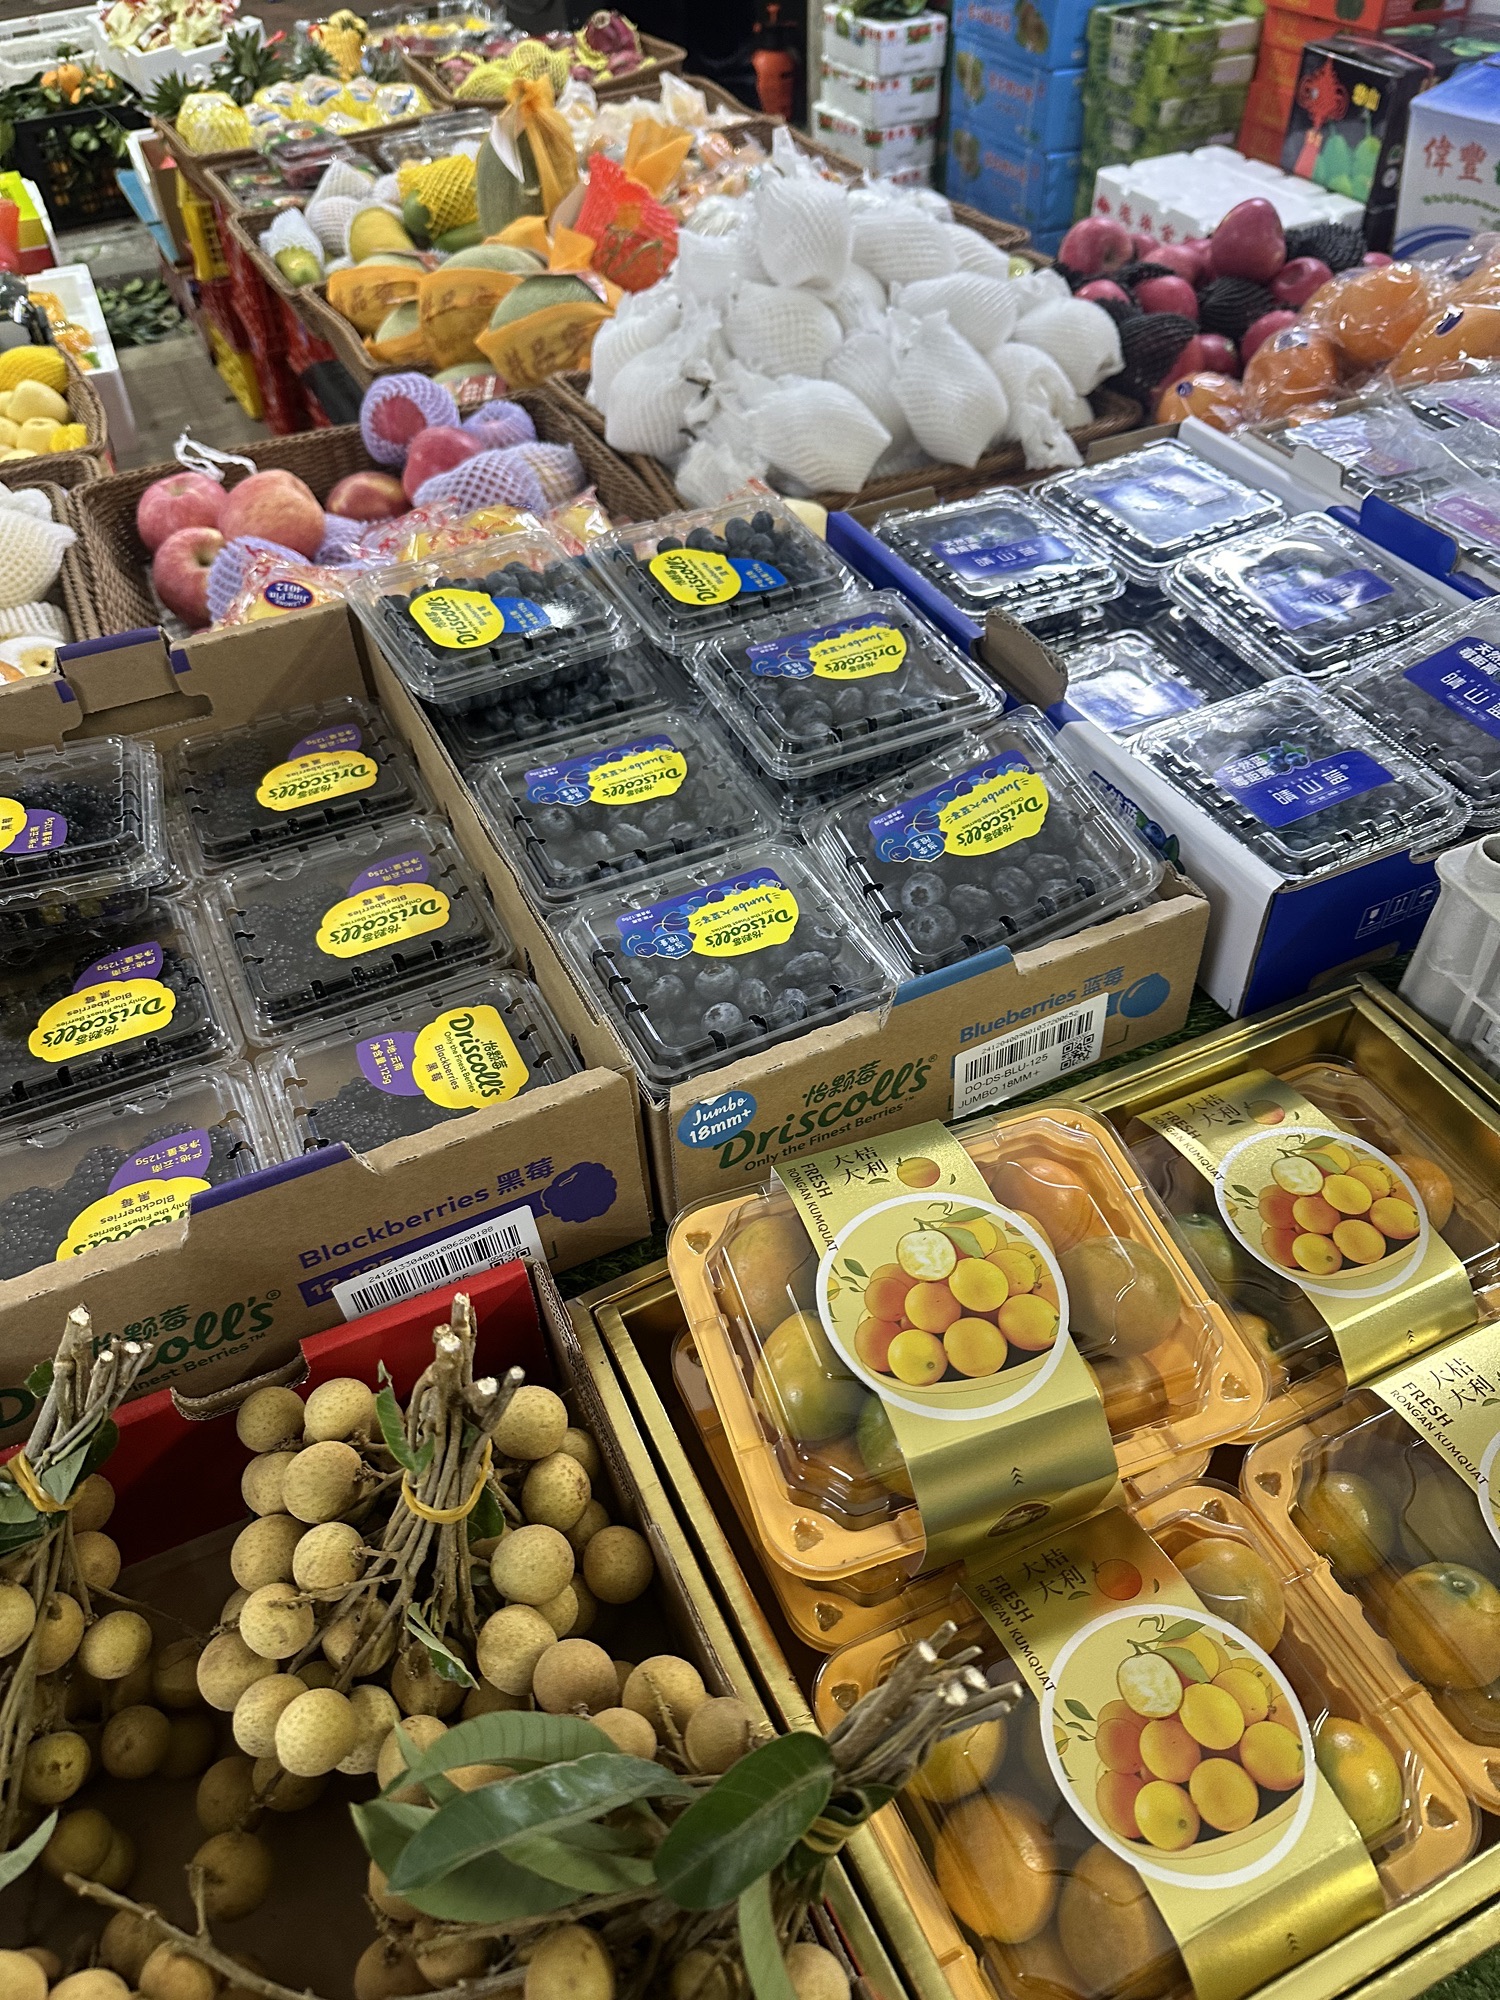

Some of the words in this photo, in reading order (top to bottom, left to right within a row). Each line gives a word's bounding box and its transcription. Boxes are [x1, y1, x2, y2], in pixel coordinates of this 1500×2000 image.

[275, 582, 304, 594] 4012
[664, 556, 717, 602] Driscoll's
[425, 596, 478, 645] Driscoll's
[825, 645, 902, 672] Driscoll's
[268, 764, 371, 800] Driscoll's
[602, 768, 683, 799] Driscoll's
[956, 796, 1043, 847] Driscoll's
[329, 899, 442, 945] Driscoll's
[347, 894, 408, 917] Blackberries
[704, 909, 794, 948] Driscoll's
[40, 997, 166, 1047] Driscoll's
[66, 992, 133, 1017] Blackberries
[960, 989, 1076, 1044] Blueberries
[1081, 965, 1125, 998] 蓝莓
[369, 1042, 392, 1085] 净含量:125g
[382, 1038, 405, 1071] 产地:云南
[425, 1061, 444, 1083] 黑莓
[434, 1044, 460, 1090] Blackberries
[449, 1013, 503, 1098] Driscoll's
[483, 1040, 508, 1071] 怡颗莓
[462, 1073, 476, 1093] Berries
[801, 1059, 882, 1108] 怡颗莓
[958, 1086, 999, 1110] JUMBO
[1002, 1069, 1041, 1091] 18MM+
[965, 1053, 1049, 1095] DO-DS-BLU-125
[693, 1095, 747, 1126] Jumbo
[1184, 1093, 1225, 1115] 大桔
[1199, 1103, 1241, 1128] 大利
[689, 1108, 752, 1144] 18mm+
[1160, 1110, 1202, 1139] FRESH
[135, 1139, 201, 1166] 净含量:125g
[151, 1148, 202, 1174] 产地:云南
[745, 1153, 778, 1172] Only
[782, 1141, 806, 1158] the
[810, 1122, 852, 1149] Finest
[829, 1146, 878, 1170] 大桔
[1183, 1142, 1225, 1181] KUMQUAT
[801, 1162, 833, 1199] FRESH
[839, 1158, 889, 1186] 大利
[100, 1194, 175, 1225] Blackberries
[120, 1190, 151, 1208] 黑莓
[154, 1207, 170, 1217] the
[298, 1188, 490, 1269] Blackberries
[496, 1156, 555, 1195] 黑莓
[88, 1224, 122, 1239] Berries
[123, 1213, 152, 1228] Finest
[807, 1201, 839, 1252] KUMQUAT
[128, 1367, 180, 1392] inest
[1448, 1374, 1496, 1411] 大利
[1402, 1382, 1454, 1428] FRESH
[1390, 1389, 1437, 1432] RONG'AN
[1434, 1431, 1489, 1485] KUMQUAT
[1018, 1548, 1069, 1581] 大桔
[989, 1575, 1035, 1623] FRESH
[1034, 1563, 1087, 1605] 大利
[975, 1583, 1014, 1628] RONG'AN
[1009, 1627, 1057, 1692] KUMQUAT
